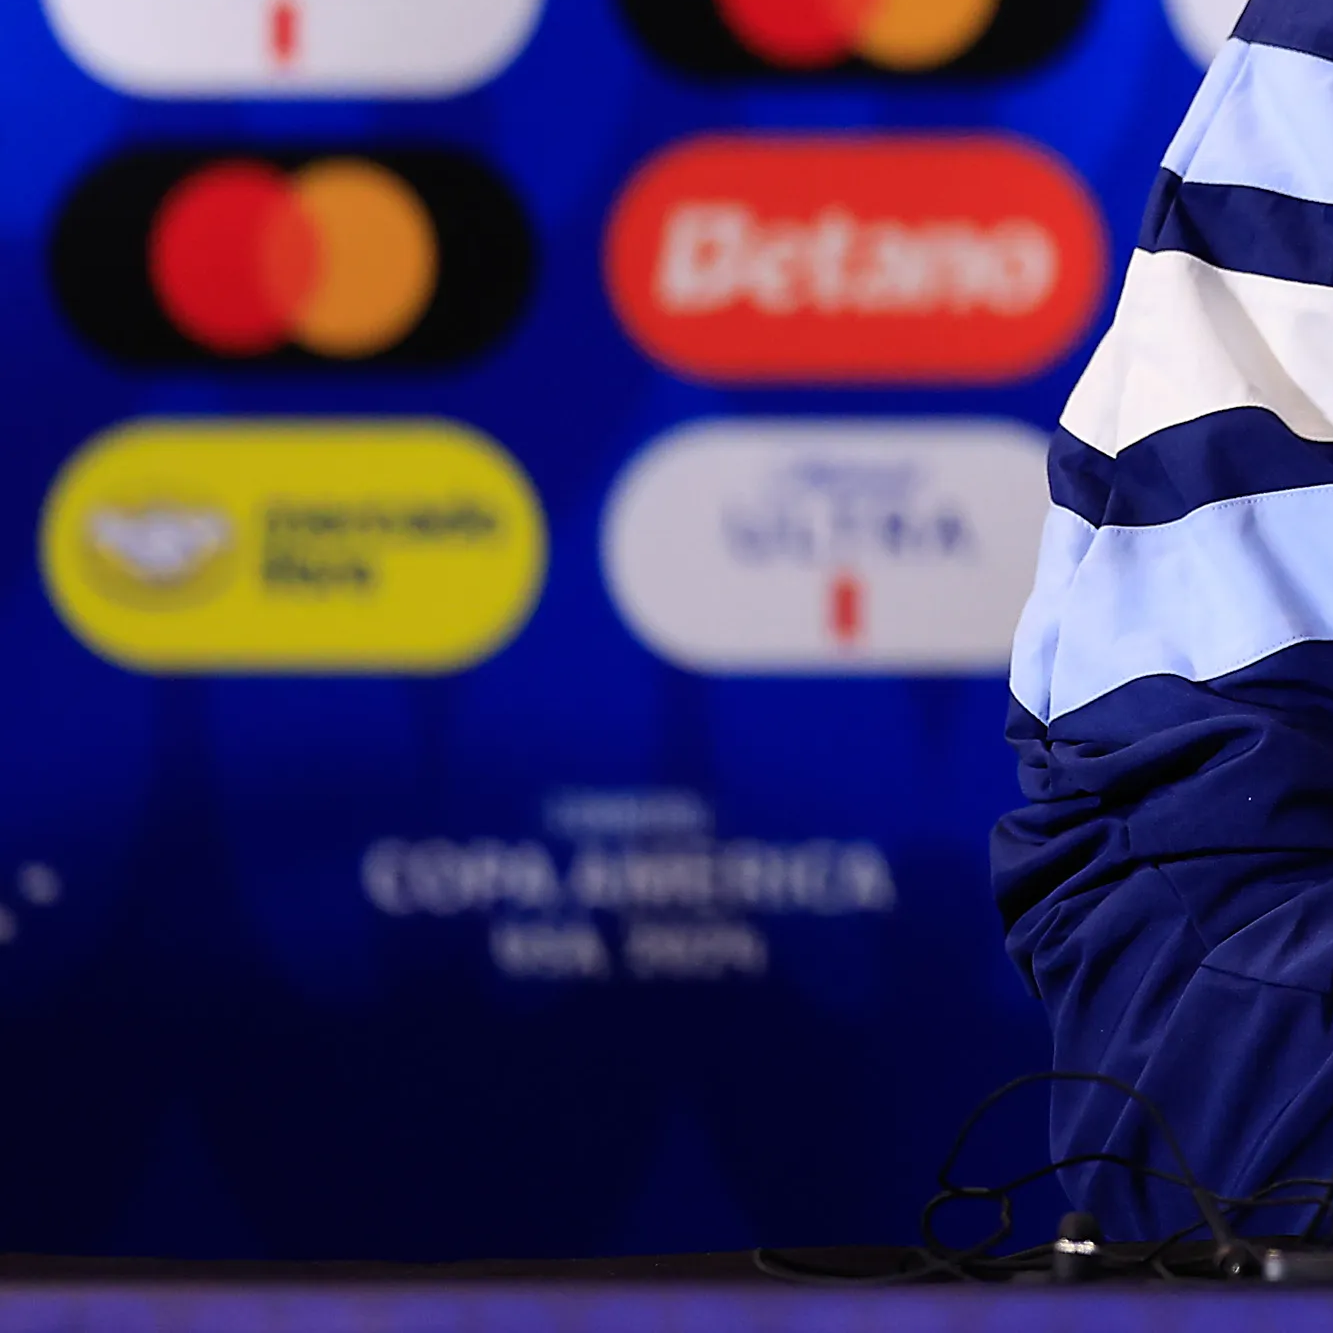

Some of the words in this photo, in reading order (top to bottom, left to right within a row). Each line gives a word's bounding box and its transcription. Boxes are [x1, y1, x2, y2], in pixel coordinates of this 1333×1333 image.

[656, 204, 1057, 311] Betano
[259, 496, 505, 542] mercado
[722, 502, 972, 561] ULTRA
[257, 546, 376, 593] libre
[361, 835, 557, 915] COPA
